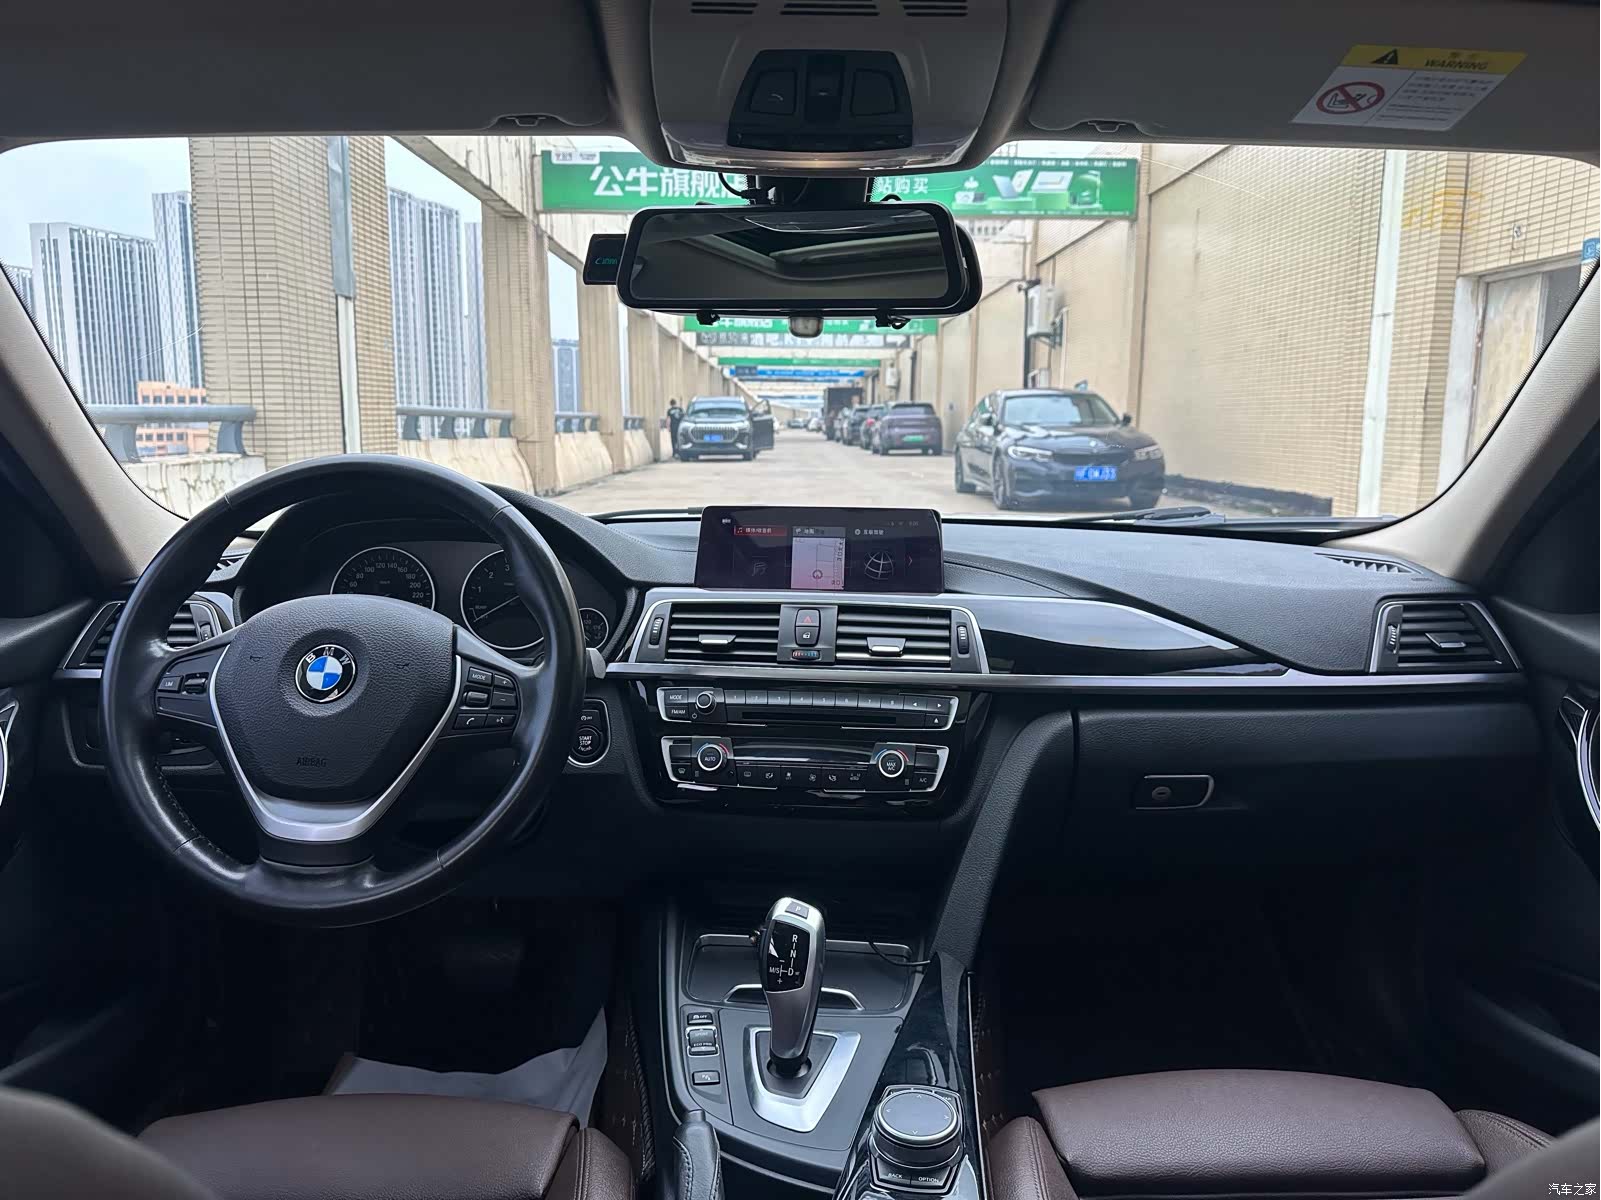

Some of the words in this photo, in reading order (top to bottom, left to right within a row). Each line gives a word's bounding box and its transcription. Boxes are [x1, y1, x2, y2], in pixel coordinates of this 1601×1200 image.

[1424, 58, 1488, 71] WARNING
[305, 646, 351, 665] BMW
[471, 673, 486, 681] MODE
[792, 934, 798, 943] R
[789, 949, 797, 958] N
[769, 966, 780, 975] M/S
[787, 967, 794, 976] D
